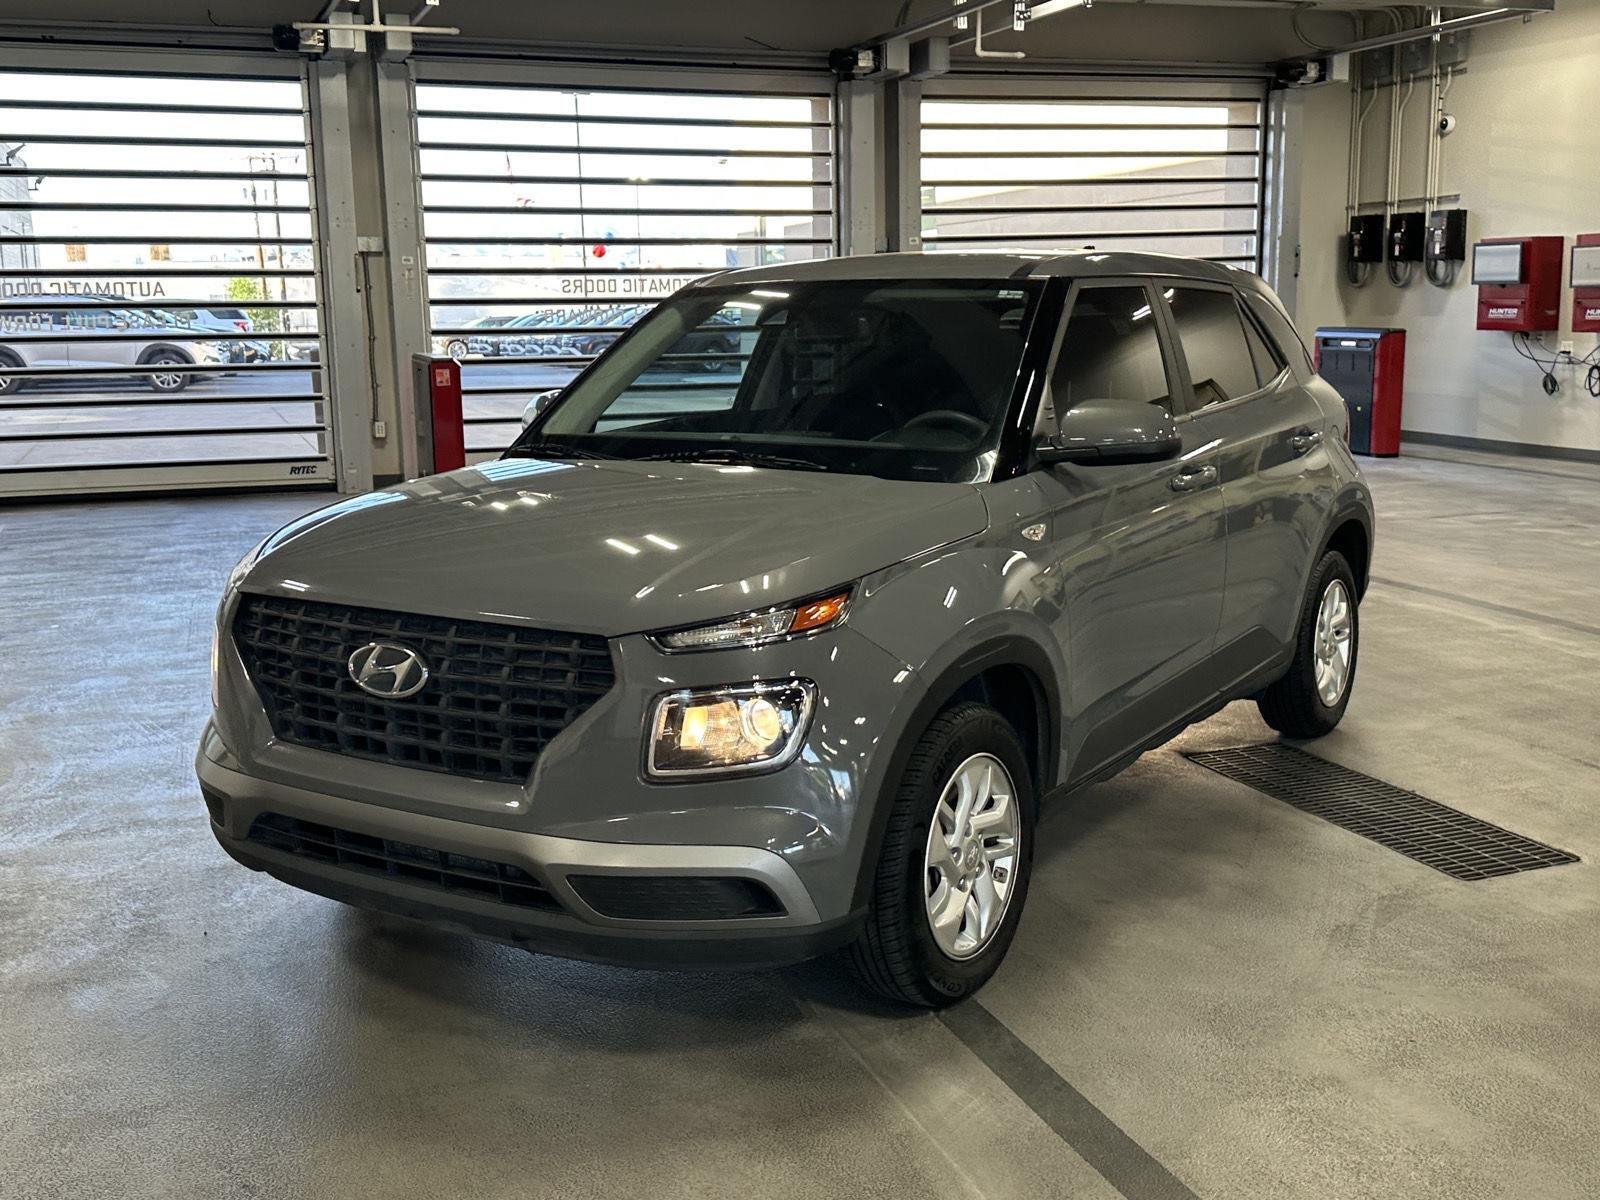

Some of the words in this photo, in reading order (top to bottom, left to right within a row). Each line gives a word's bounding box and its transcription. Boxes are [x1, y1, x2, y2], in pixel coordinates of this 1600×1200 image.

[1489, 307, 1518, 316] HUNTER
[1585, 308, 1600, 317] HUN
[289, 465, 317, 475] RYTEC
